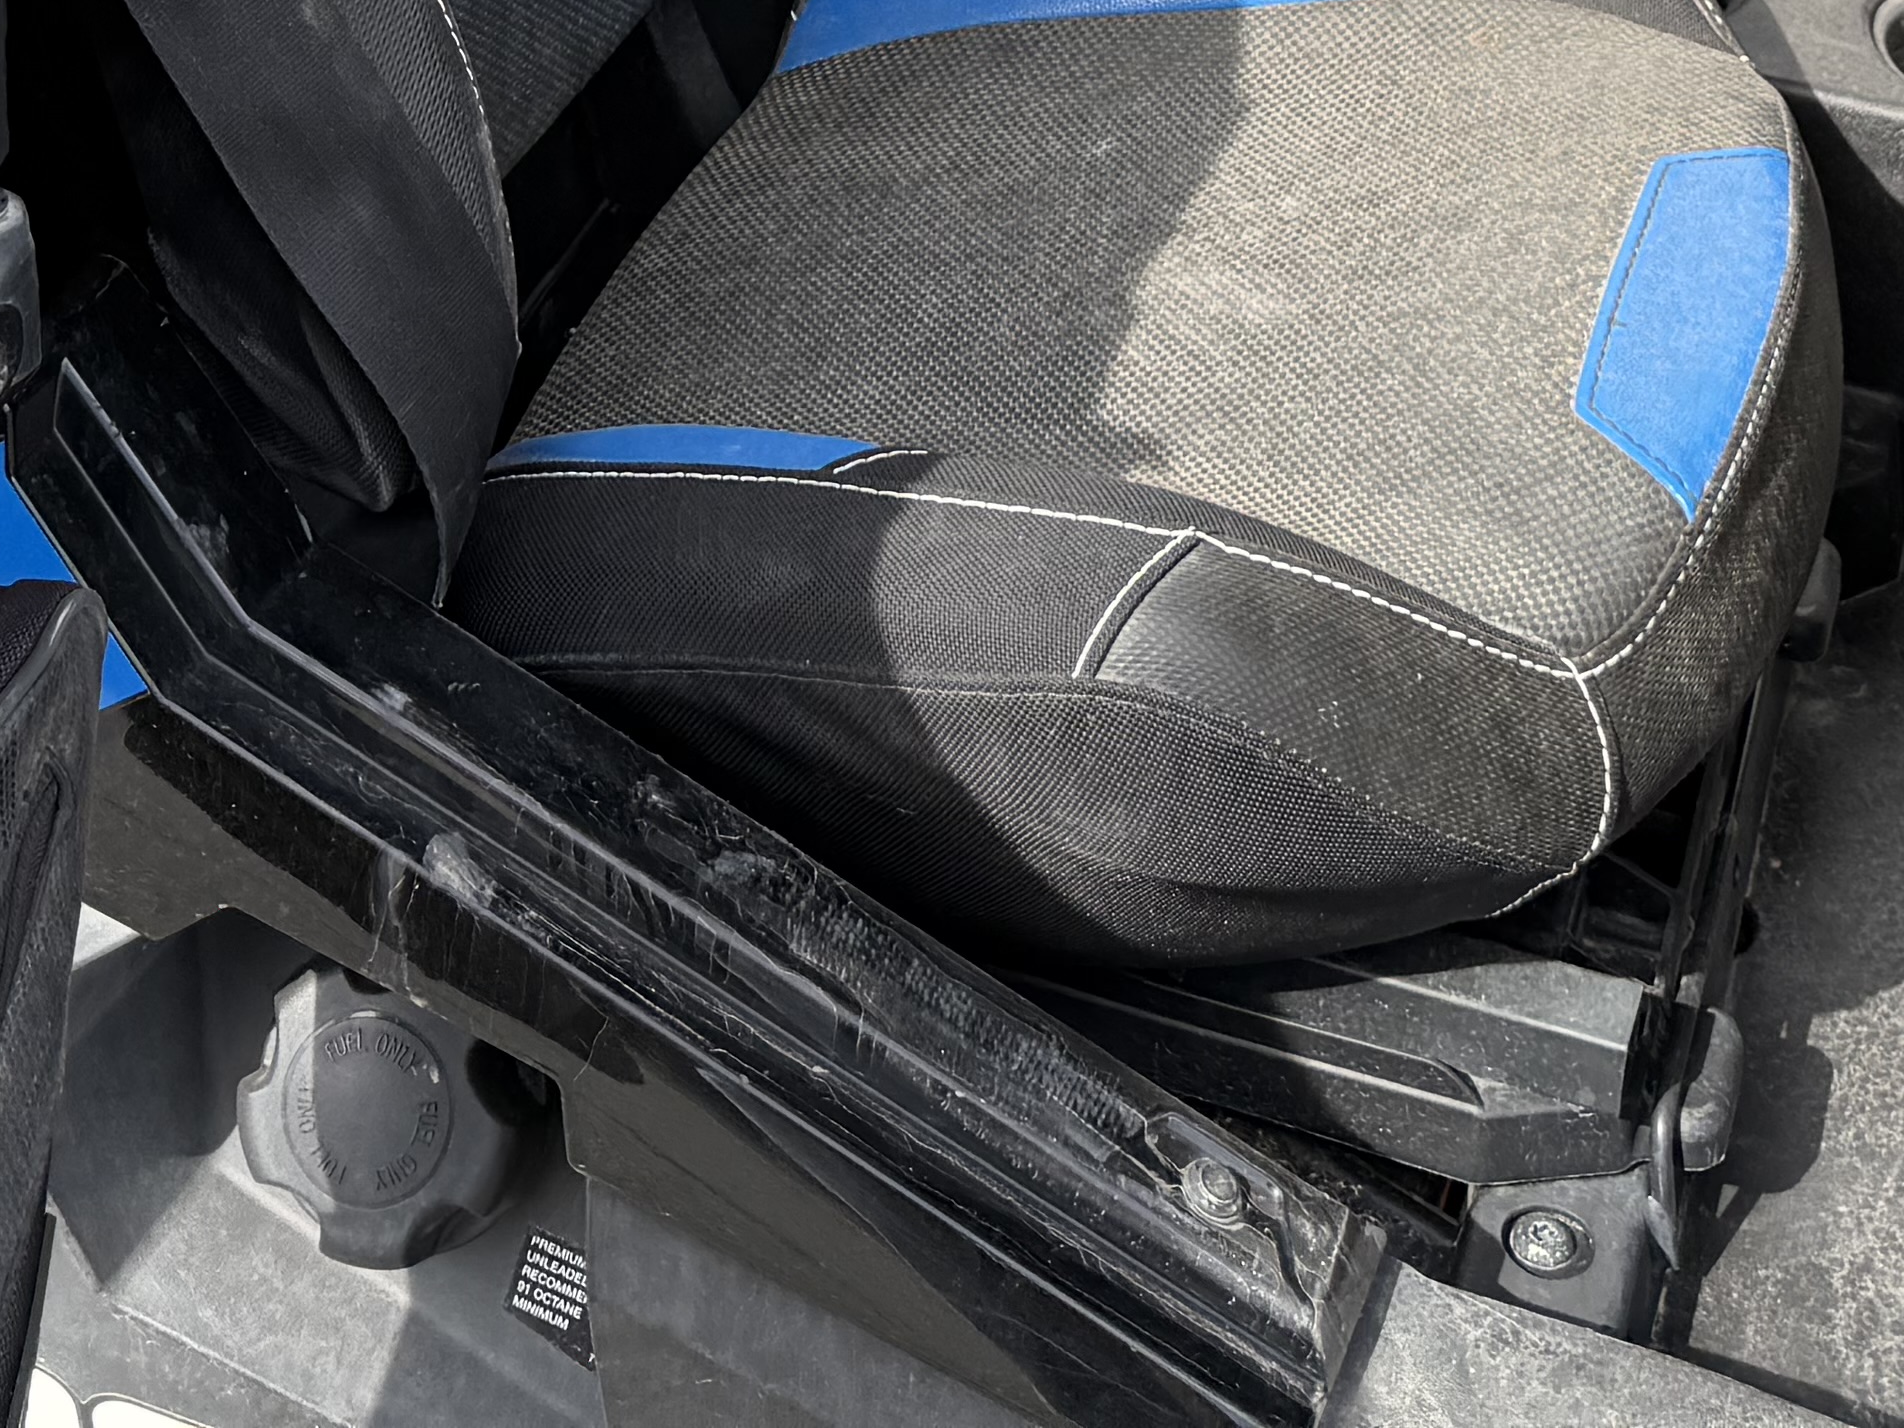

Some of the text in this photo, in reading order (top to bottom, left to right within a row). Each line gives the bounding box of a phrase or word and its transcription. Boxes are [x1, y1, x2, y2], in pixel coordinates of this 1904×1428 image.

[324, 1027, 418, 1077] FUEL ONLY
[516, 1280, 583, 1320] 91 OCTANE
[521, 1264, 588, 1304] RECOMME
[511, 1294, 570, 1331] MINIMUM
